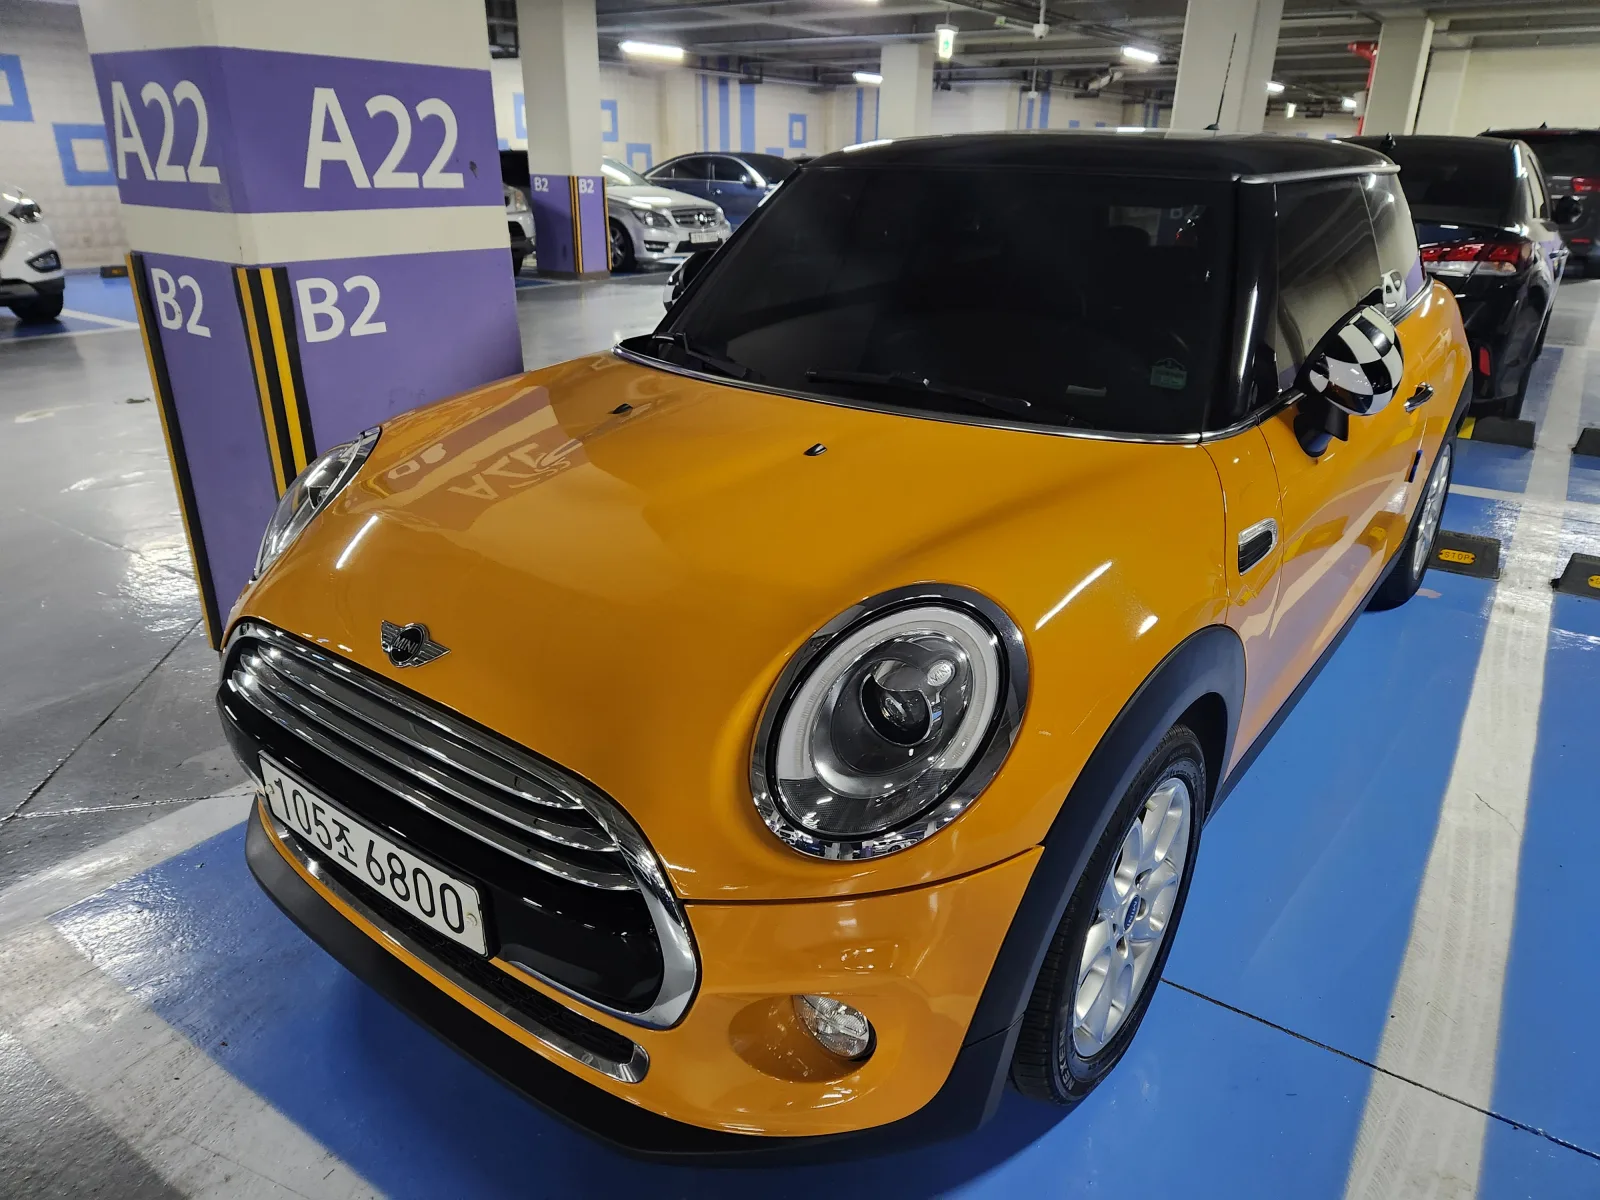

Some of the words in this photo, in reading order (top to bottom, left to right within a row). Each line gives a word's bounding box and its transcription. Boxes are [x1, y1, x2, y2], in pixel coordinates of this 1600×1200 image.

[111, 80, 220, 184] A22
[303, 87, 465, 189] A22
[533, 177, 549, 193] B2
[578, 178, 594, 194] B2
[151, 267, 211, 338] B2
[296, 275, 387, 343] B2
[1444, 551, 1471, 561] STOP
[393, 635, 420, 655] MINI
[930, 665, 951, 684] MINI
[273, 777, 358, 868] 105조
[365, 839, 465, 935] 6800
[1126, 901, 1138, 927] MINI
